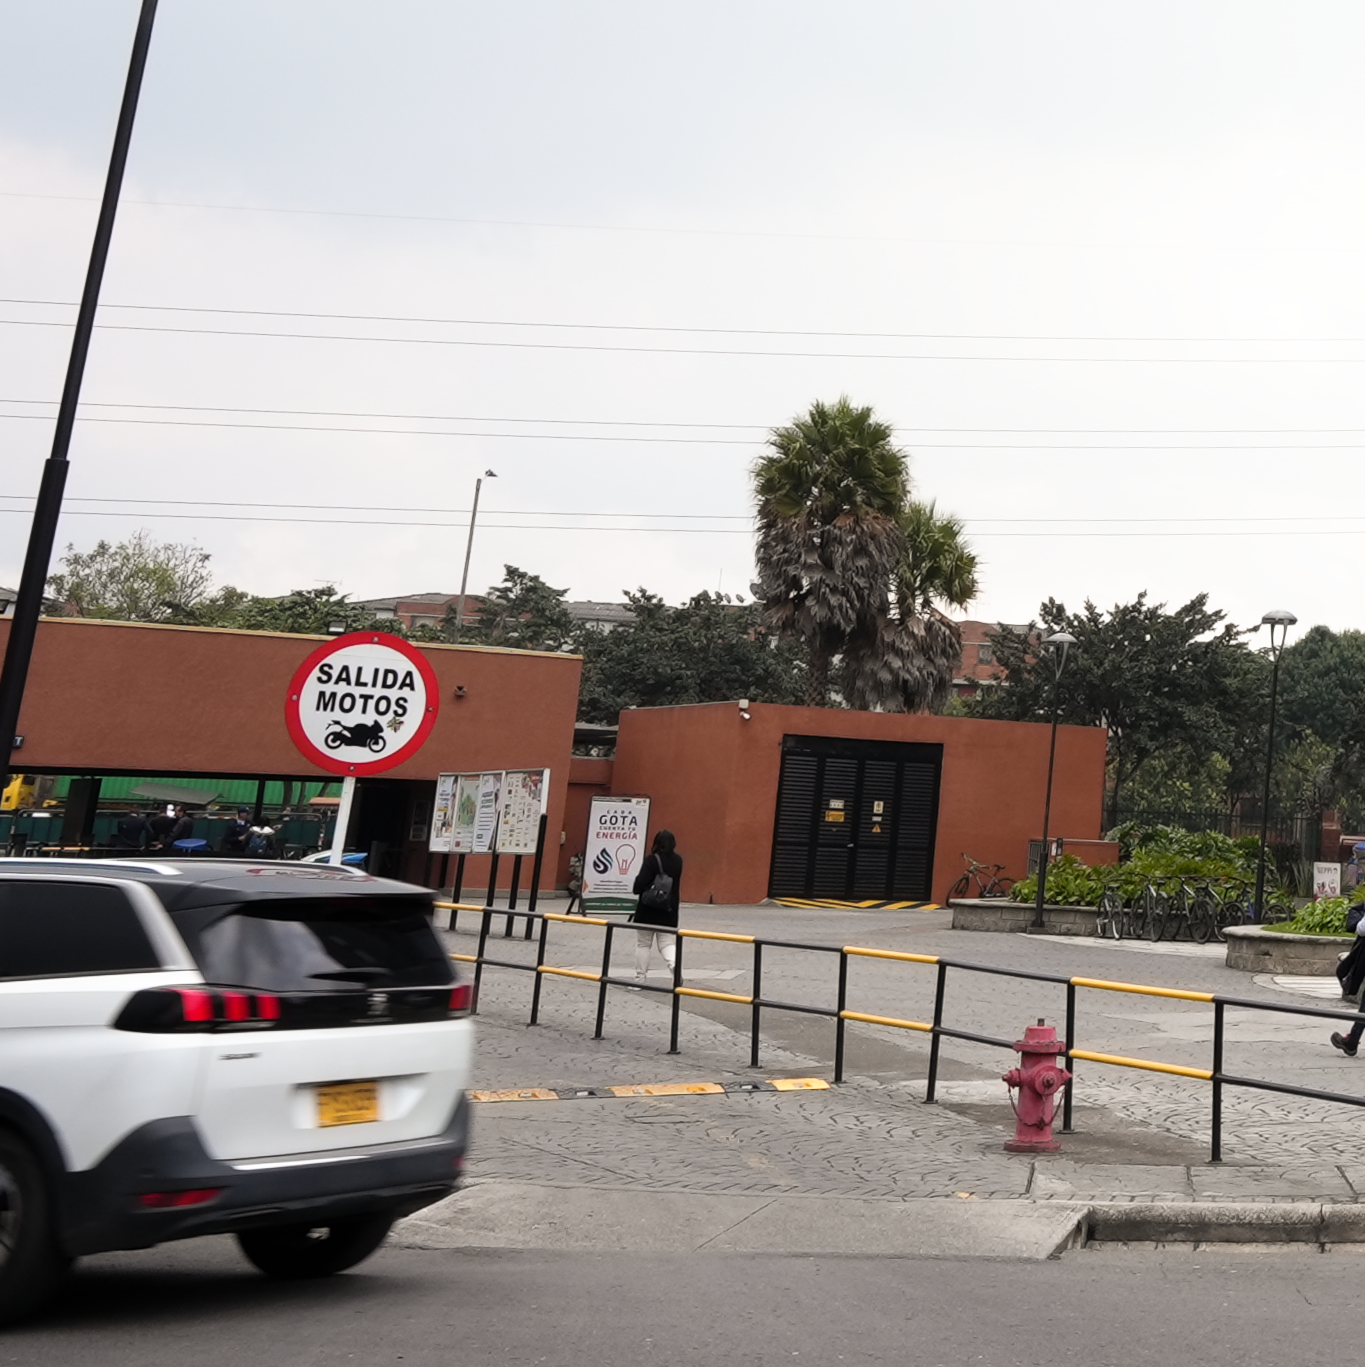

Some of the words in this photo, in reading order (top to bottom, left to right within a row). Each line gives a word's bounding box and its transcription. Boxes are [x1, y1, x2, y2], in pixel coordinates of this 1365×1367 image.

[316, 663, 415, 691] SALIDA
[315, 691, 408, 717] MOTOS
[599, 815, 638, 826] GOTA
[596, 831, 638, 840] ENERGÍA
